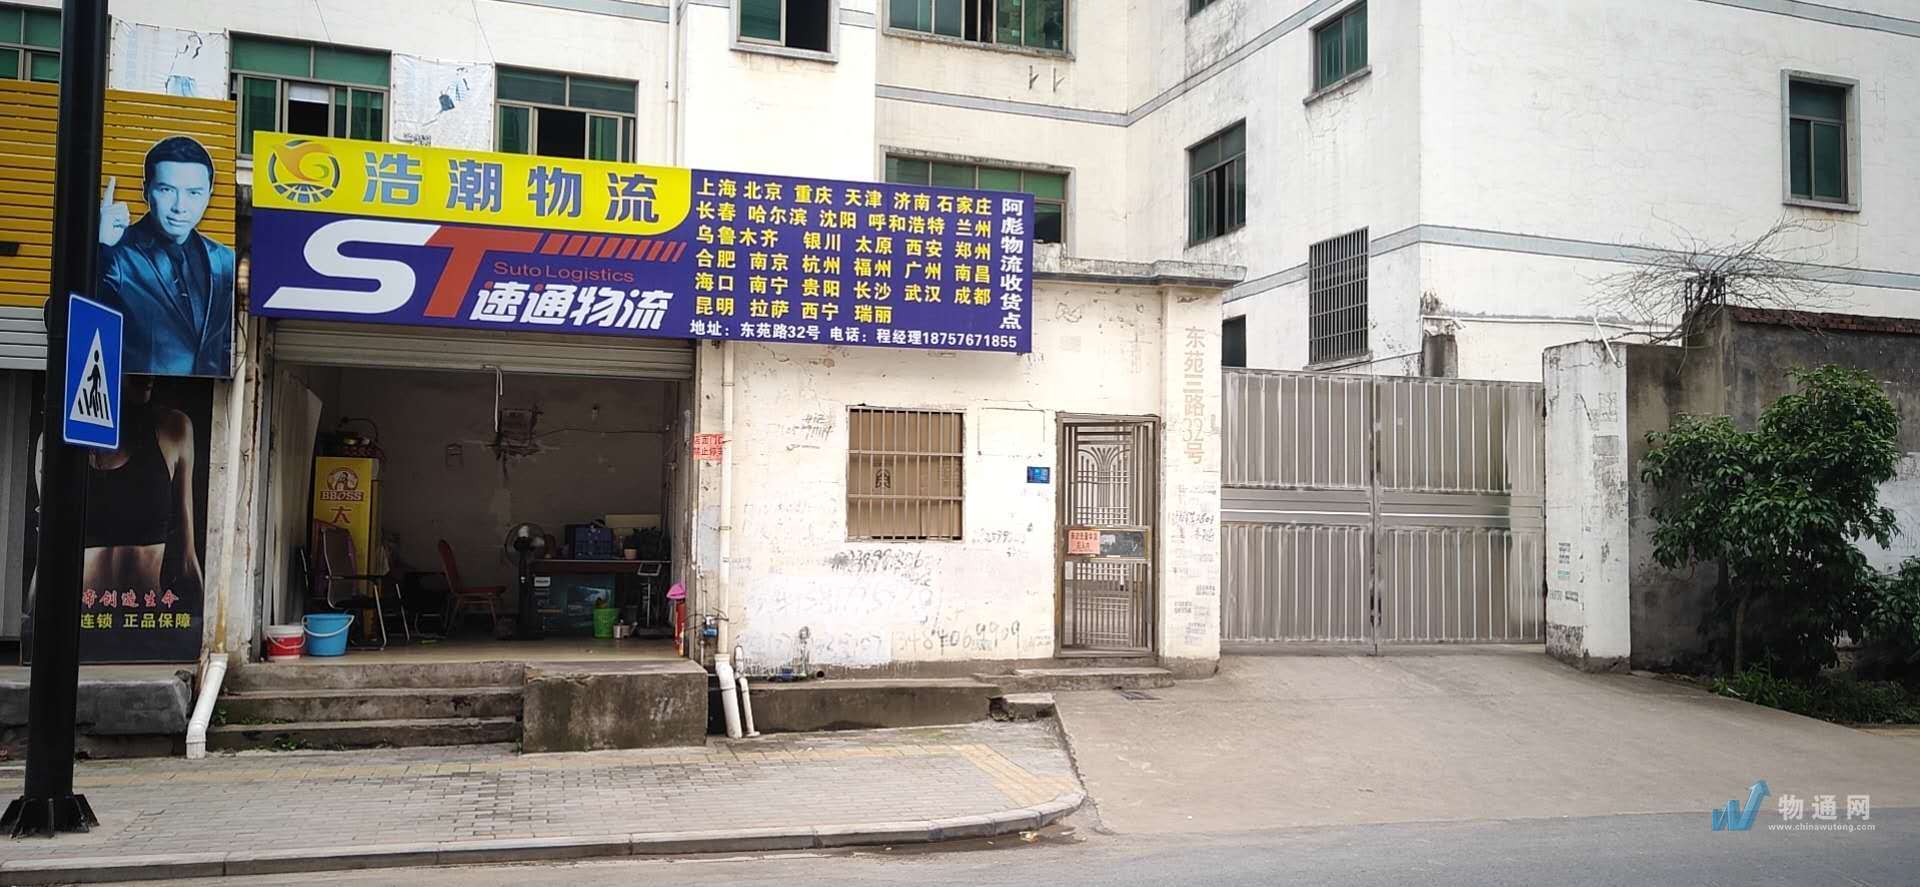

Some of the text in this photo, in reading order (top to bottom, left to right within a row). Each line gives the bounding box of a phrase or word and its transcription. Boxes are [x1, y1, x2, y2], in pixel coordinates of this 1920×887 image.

[362, 151, 660, 224] 浩潮物流
[697, 178, 993, 216] 上海 北京 重庆 天津 济南 石家庄
[696, 201, 991, 238] 长春 哈尔滨 沈阳 呼和浩特 兰州
[696, 225, 991, 261] 乌鲁木齐 银川 太原 西安 郑州
[263, 219, 541, 318] ST
[494, 261, 635, 283] Suto Logistics
[696, 249, 990, 284] 合肥 南京 杭州 福州 广州 南昌
[999, 198, 1025, 330] 阿彪物流收货点
[470, 281, 674, 330] 速通物流
[695, 272, 991, 306] 海口 南宁 贵阳 长沙 武汉 成都
[695, 297, 893, 324] 昆明 拉萨 西宁 瑞丽
[740, 322, 821, 340] 东苑路32号
[876, 328, 1017, 348] 程经理18757671855
[1183, 325, 1205, 465] 东苑三路32号
[322, 491, 363, 501] BBOSS
[80, 612, 192, 629] 连锁 正品保障
